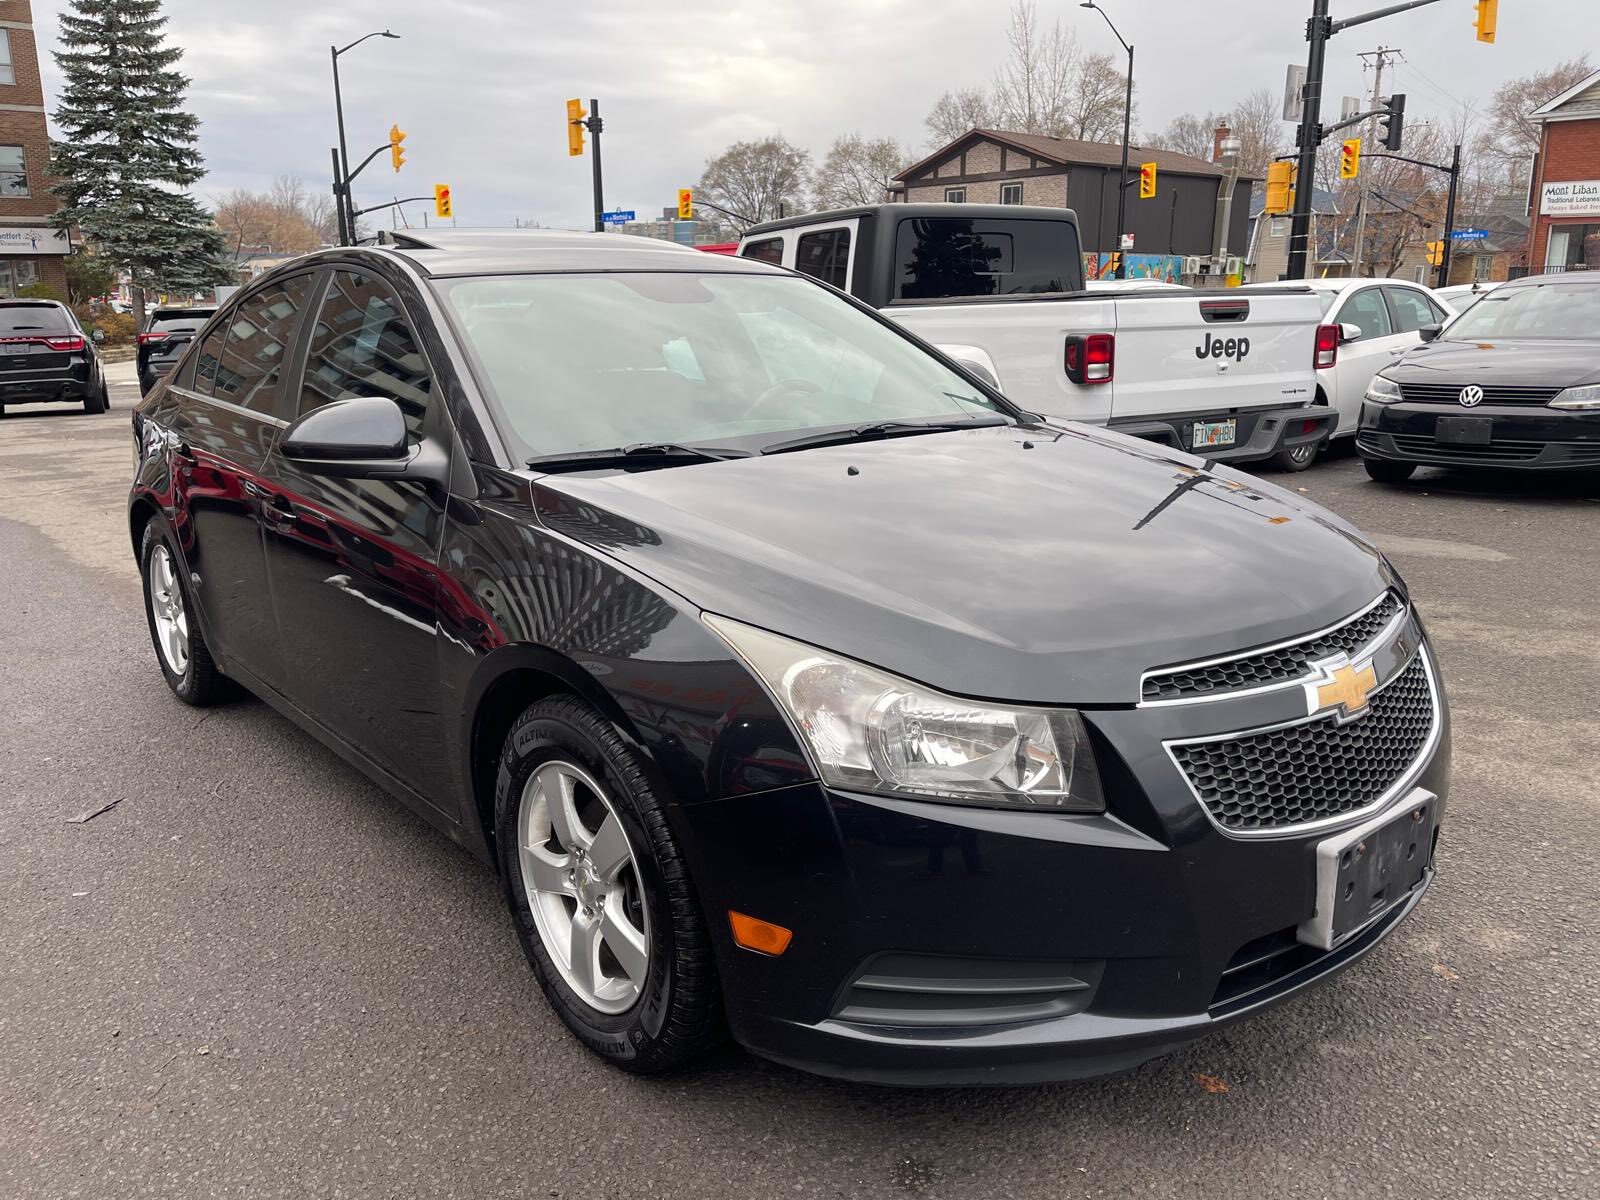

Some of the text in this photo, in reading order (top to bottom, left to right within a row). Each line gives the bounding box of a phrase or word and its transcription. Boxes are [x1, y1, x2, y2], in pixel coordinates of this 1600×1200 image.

[1545, 185, 1598, 196] Mont Liban
[1195, 332, 1250, 362] Jeep
